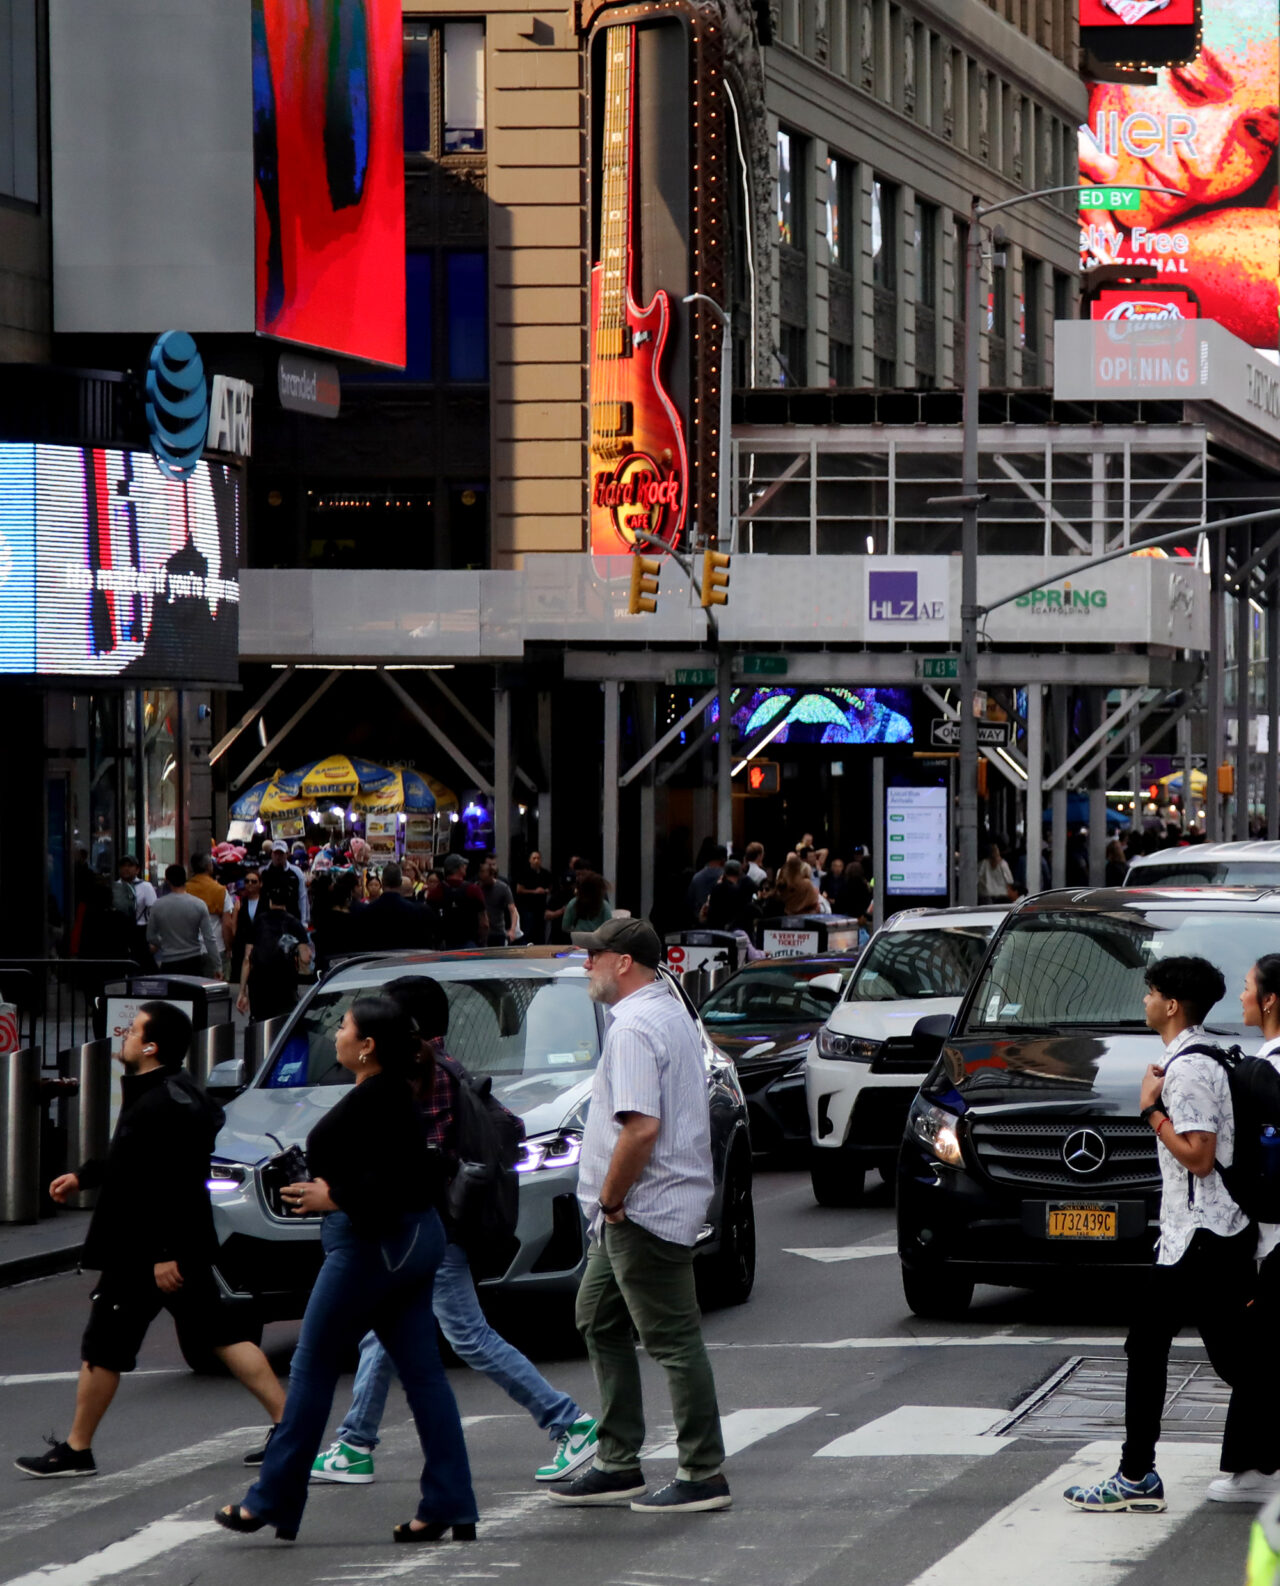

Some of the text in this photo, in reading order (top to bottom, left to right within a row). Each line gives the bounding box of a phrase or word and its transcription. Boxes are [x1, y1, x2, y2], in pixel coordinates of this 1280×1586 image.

[1110, 191, 1133, 206] BY
[1131, 227, 1189, 254] Free
[206, 374, 254, 457] AT&T
[593, 469, 680, 512] Hard Rock
[924, 660, 933, 676] W
[935, 660, 946, 676] 43
[678, 671, 688, 684] W
[691, 671, 704, 685] 43
[942, 727, 1001, 739] ON WAY
[304, 783, 356, 794] SABRETT
[797, 933, 811, 941] HOT
[1053, 1212, 1111, 1231] T732439C
